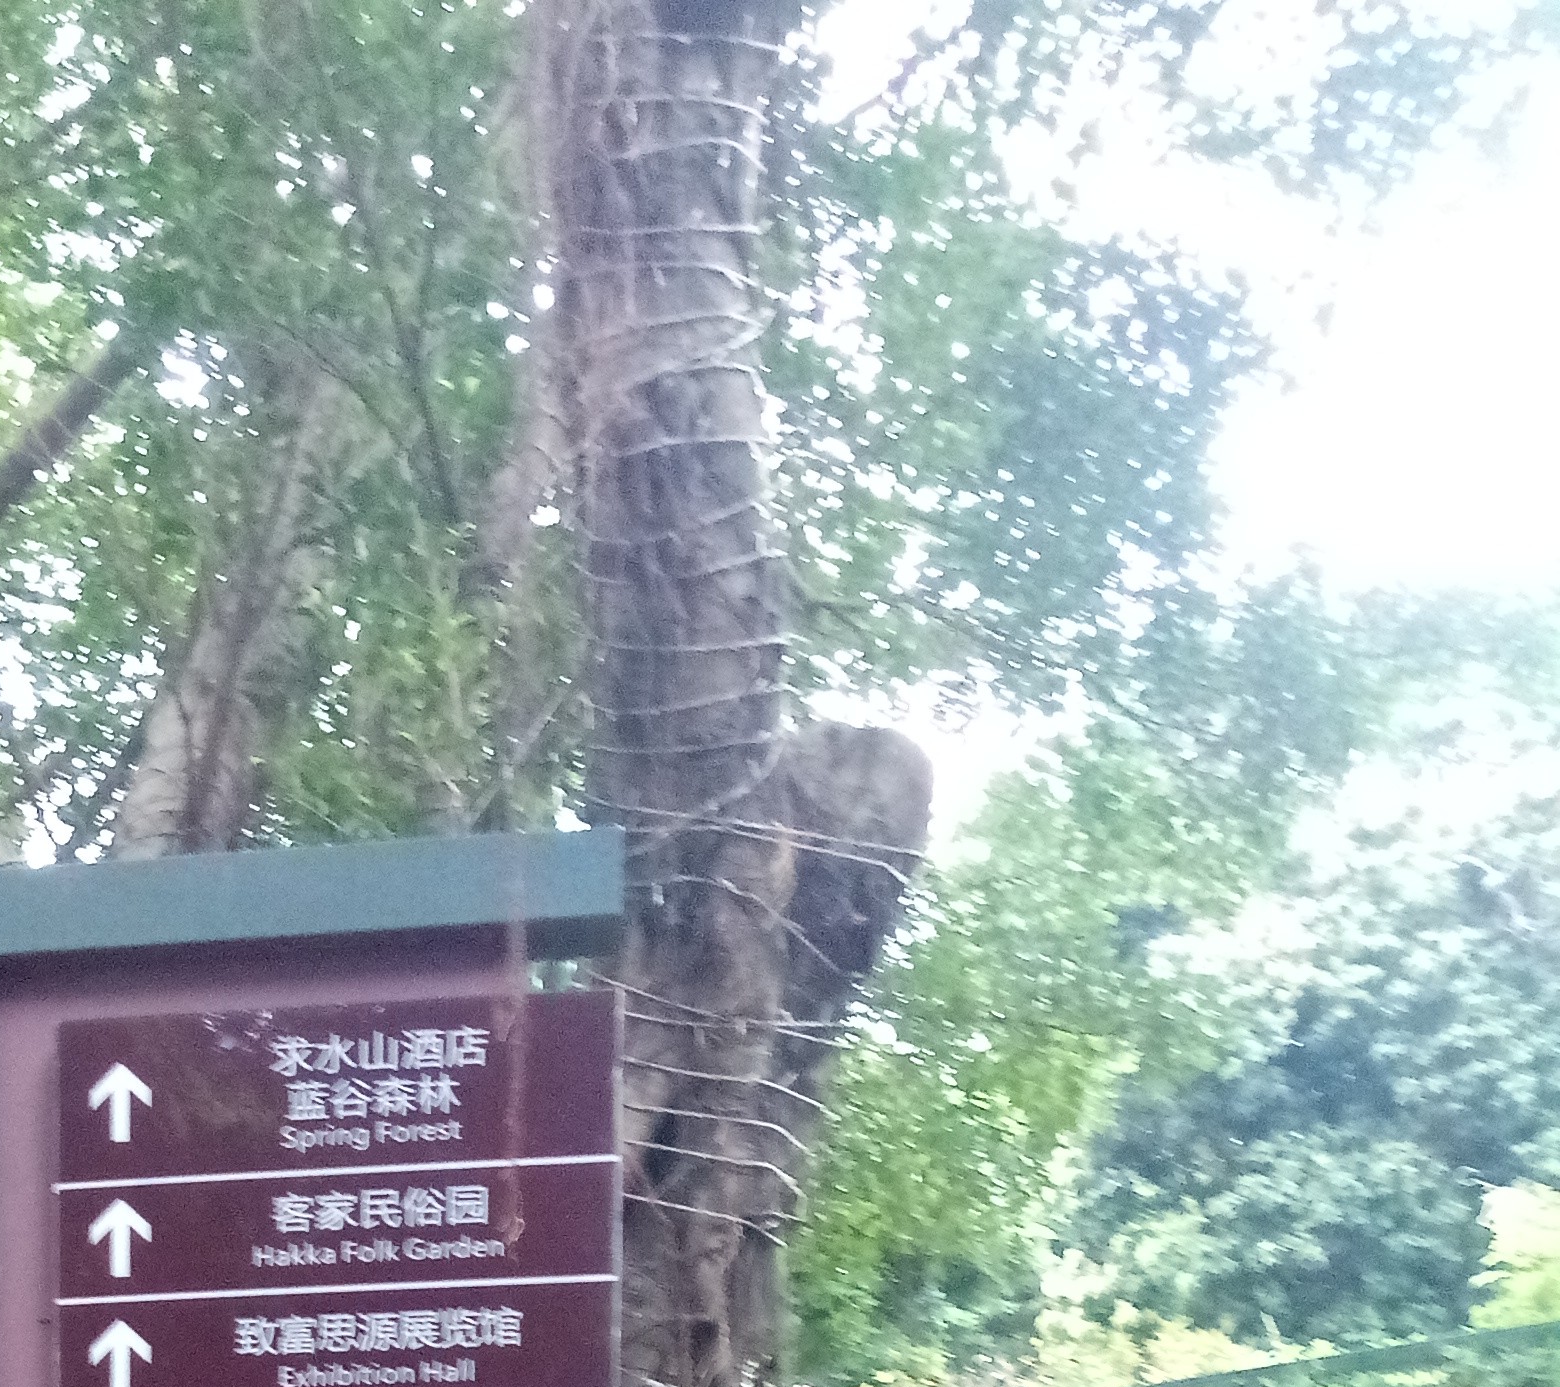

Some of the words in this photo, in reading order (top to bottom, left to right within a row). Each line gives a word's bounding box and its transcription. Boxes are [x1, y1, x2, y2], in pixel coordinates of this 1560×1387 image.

[269, 1025, 490, 1076] 求水山酒店
[281, 1071, 461, 1122] 蓝谷森林
[279, 1123, 371, 1153] Spring
[374, 1119, 463, 1144] Forest
[271, 1184, 490, 1233] 客家民俗园
[251, 1242, 338, 1267] Hakka
[340, 1238, 400, 1263] Folk
[402, 1234, 506, 1261] Garden
[234, 1305, 524, 1356] 致富思源展览馆
[419, 1358, 476, 1383] Hall
